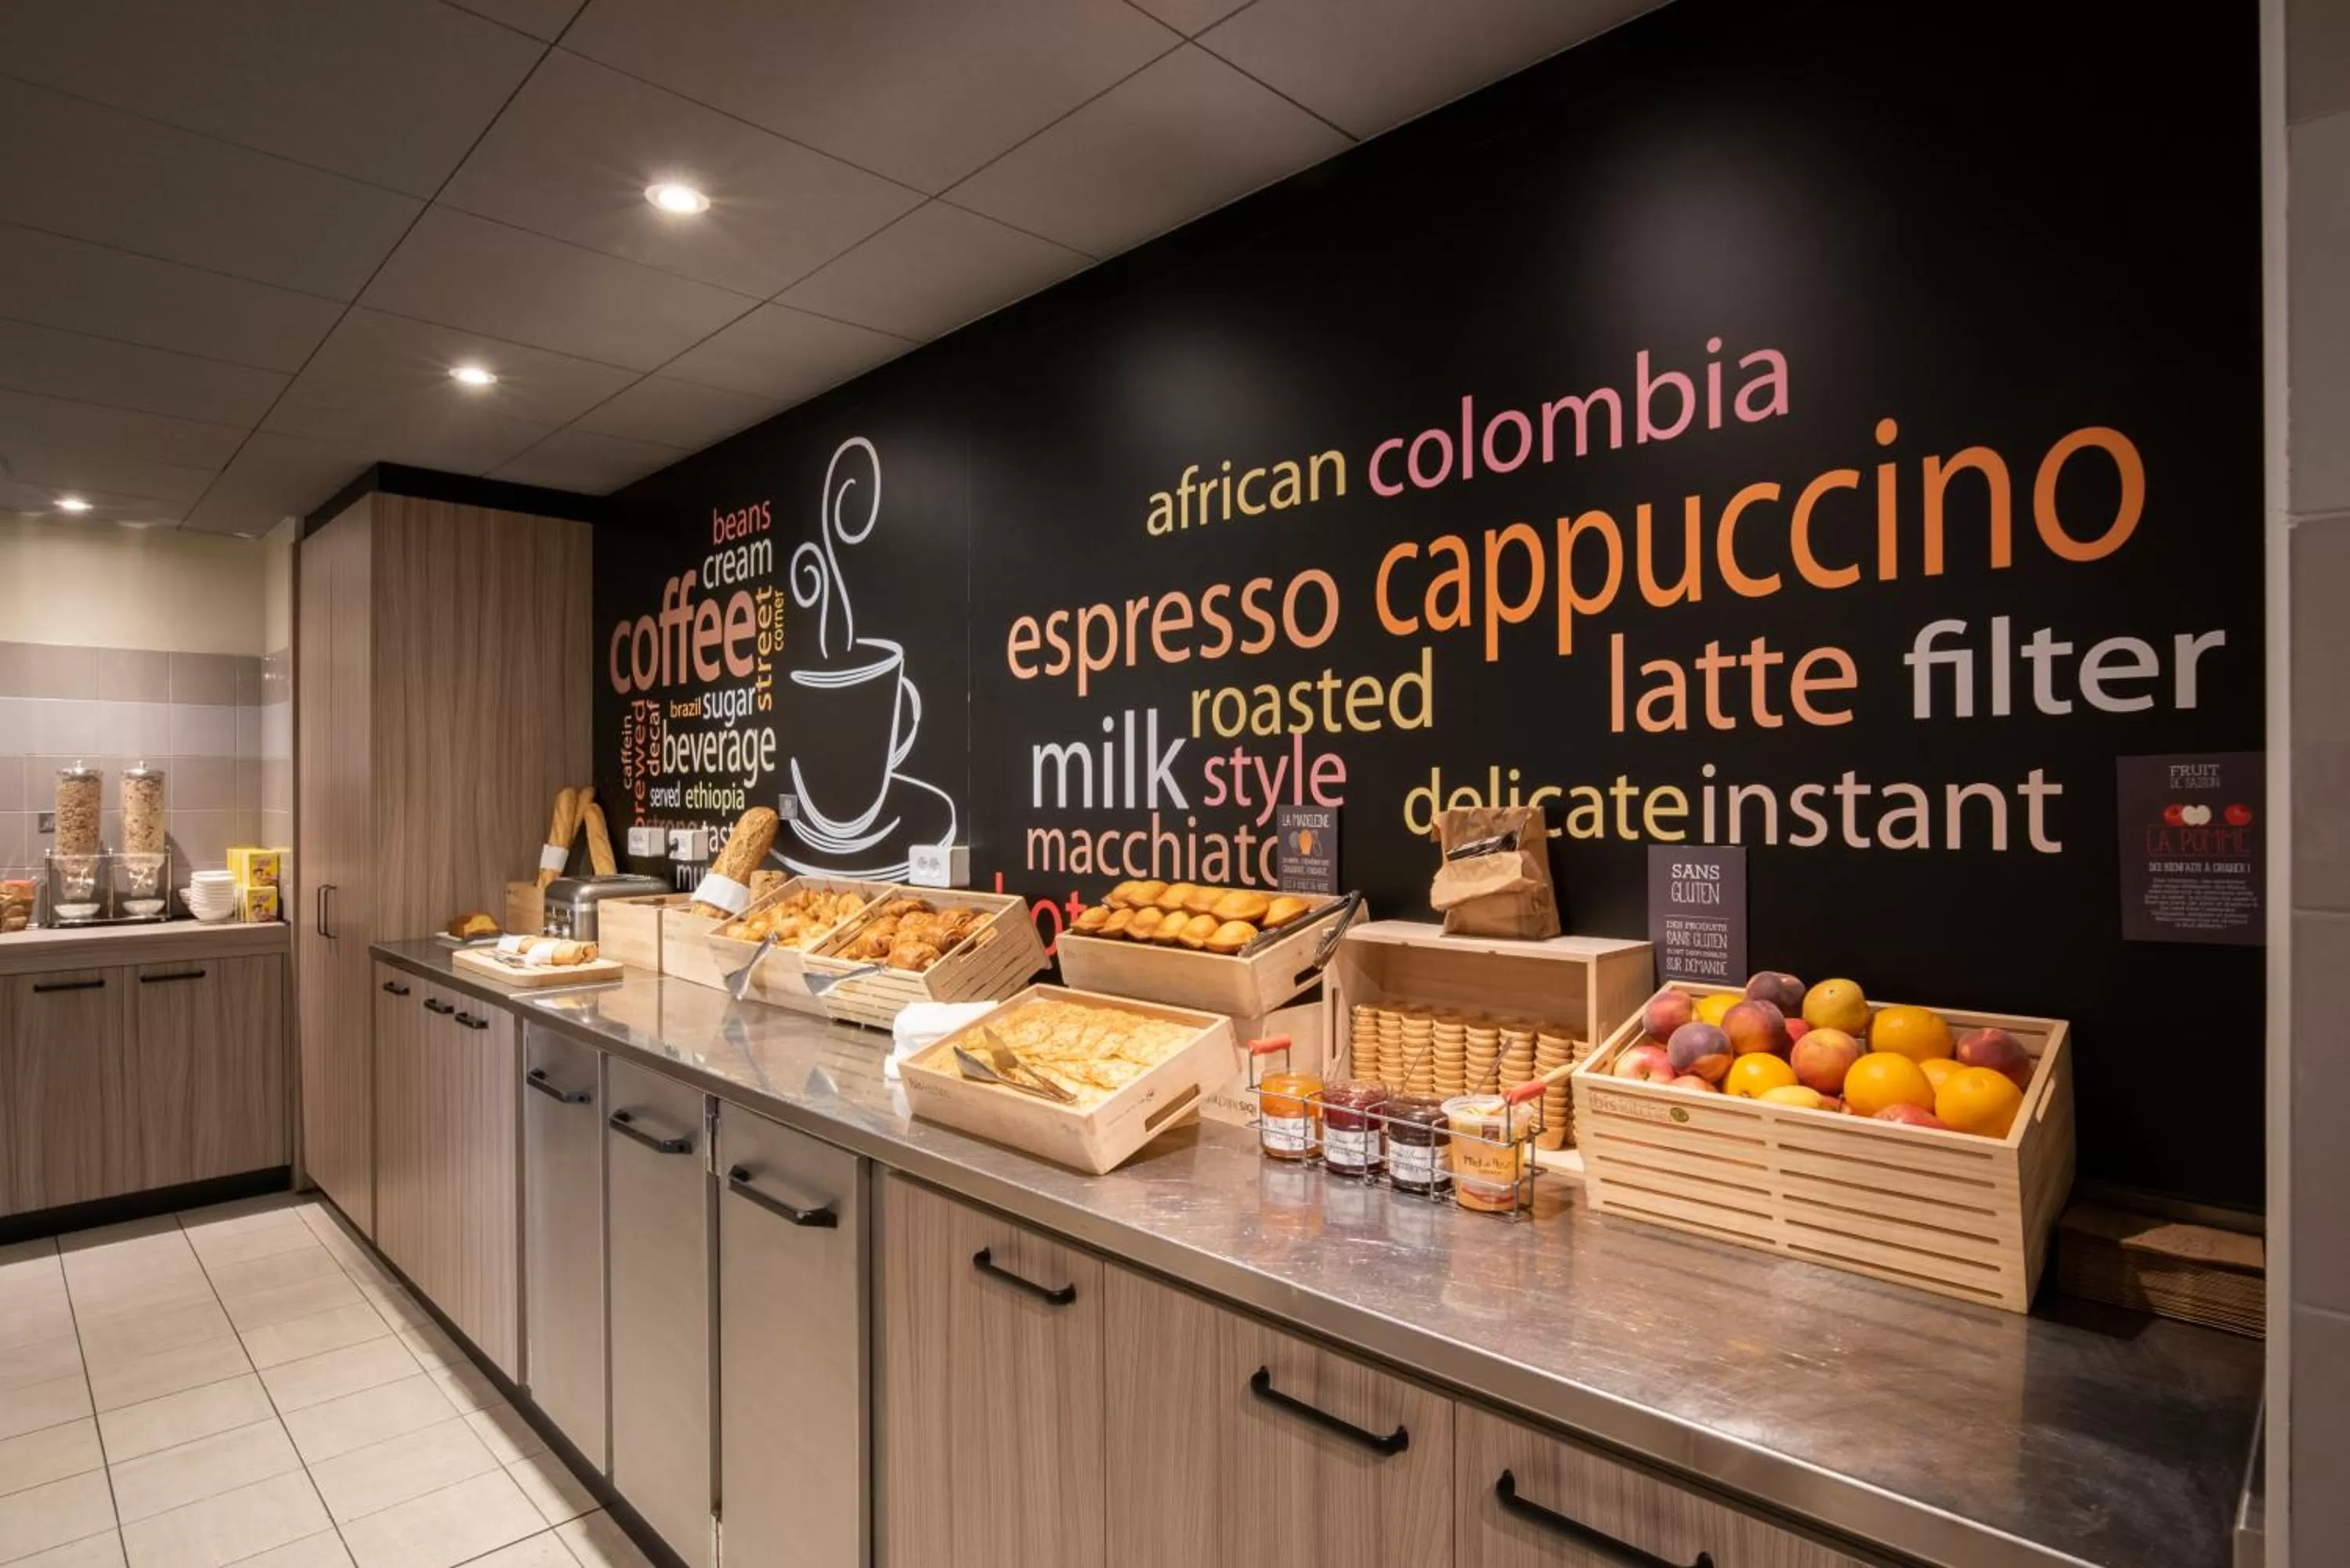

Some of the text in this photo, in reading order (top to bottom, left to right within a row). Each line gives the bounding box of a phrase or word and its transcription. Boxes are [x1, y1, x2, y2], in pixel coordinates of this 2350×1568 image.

[1368, 336, 1790, 498] colombia
[714, 500, 772, 545] beans
[1146, 450, 1347, 538] african
[703, 539, 773, 590] cream
[1376, 418, 2146, 663] cappuccino
[610, 569, 757, 694] coffee
[756, 585, 773, 712] street
[774, 590, 785, 652] corner
[1007, 569, 1340, 698] espresso
[670, 697, 702, 718] brazil
[703, 685, 757, 727] sugar
[1191, 647, 1434, 739] roasted
[1611, 633, 1858, 733] latte
[1904, 616, 2226, 721] filter
[646, 699, 660, 777] decaf
[661, 718, 776, 789] beverage
[1032, 708, 1190, 811] milk
[2169, 764, 2221, 776] FRUIT
[650, 783, 682, 809] served
[685, 780, 746, 817] ethiopia
[1203, 732, 1347, 827] style
[1703, 763, 2064, 854] instant
[1670, 881, 1721, 905] GLUTEN
[1671, 863, 1721, 880] SANS
[1666, 930, 1728, 949] SANS GLUTEN
